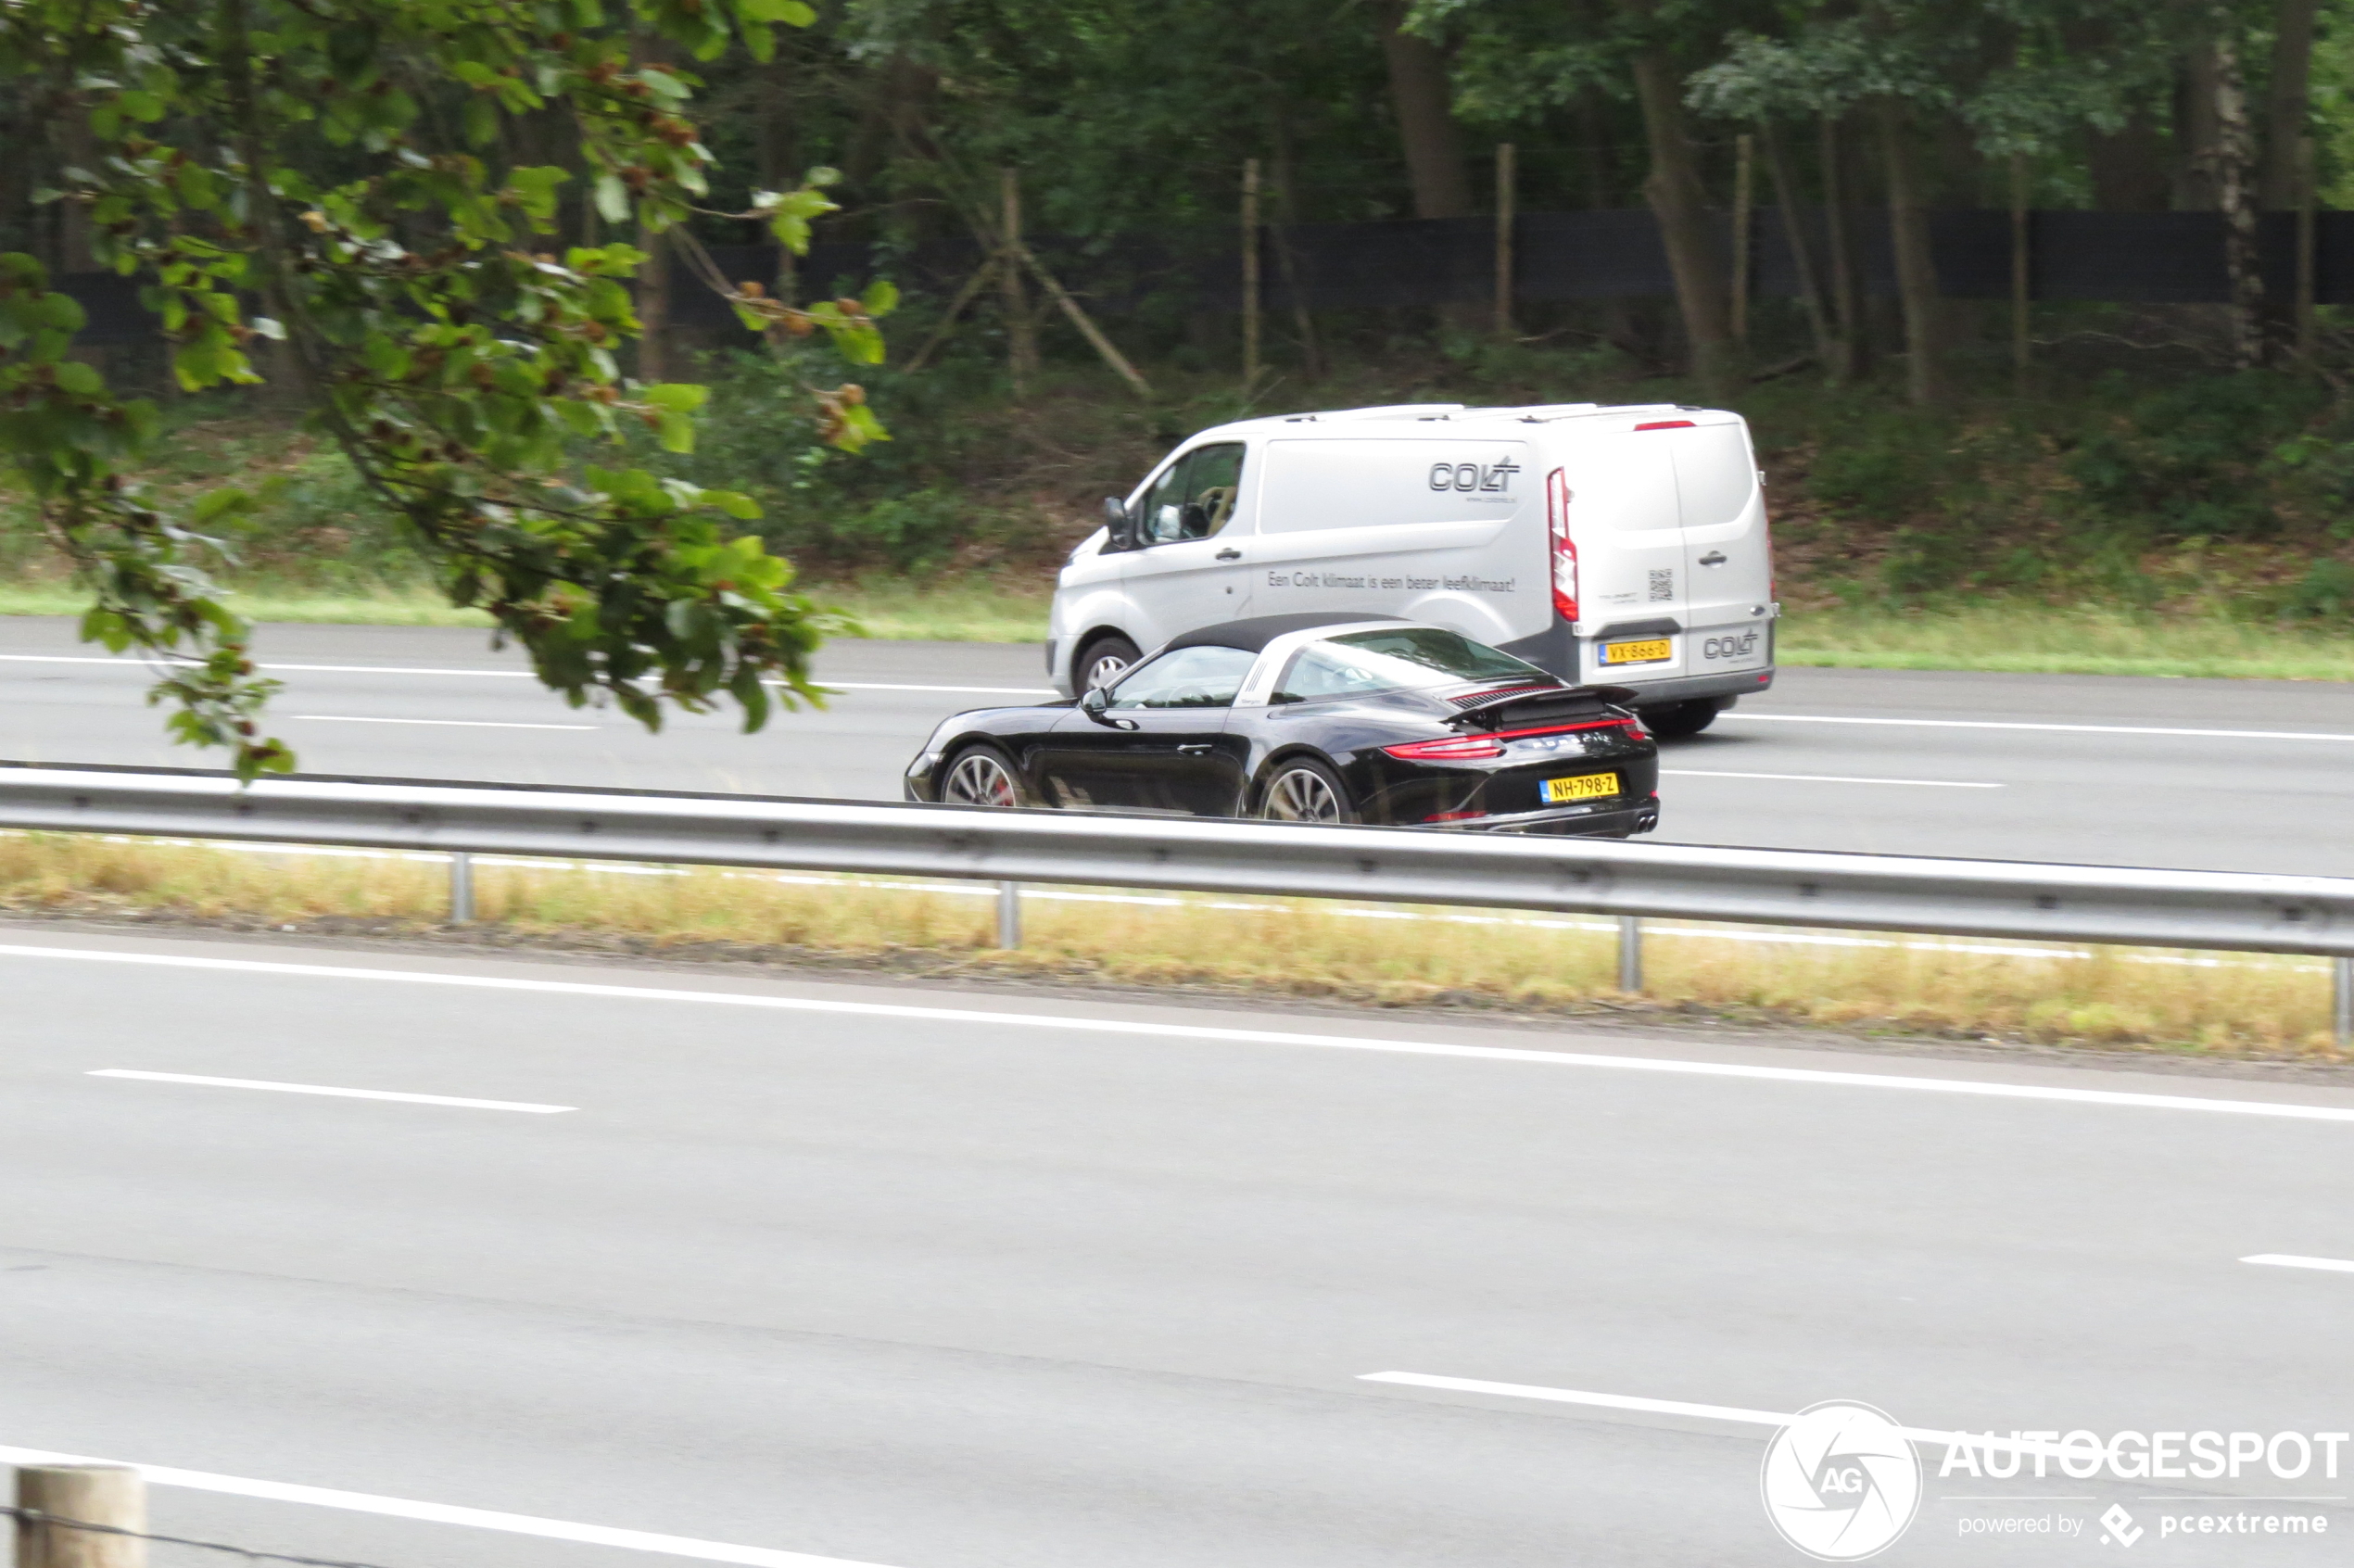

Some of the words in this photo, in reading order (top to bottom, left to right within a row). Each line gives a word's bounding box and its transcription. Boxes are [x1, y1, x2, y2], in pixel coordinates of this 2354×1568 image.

[1429, 455, 1521, 492] COLT
[1268, 570, 1289, 587] Een
[1293, 571, 1320, 588] Colt
[1323, 572, 1365, 588] klimaat
[1368, 574, 1378, 588] is
[1381, 577, 1402, 590] een
[1405, 574, 1438, 590] beter
[1609, 642, 1666, 661] VX-866-D
[1704, 627, 1758, 660] COLT
[1553, 776, 1614, 798] NH-798-Z
